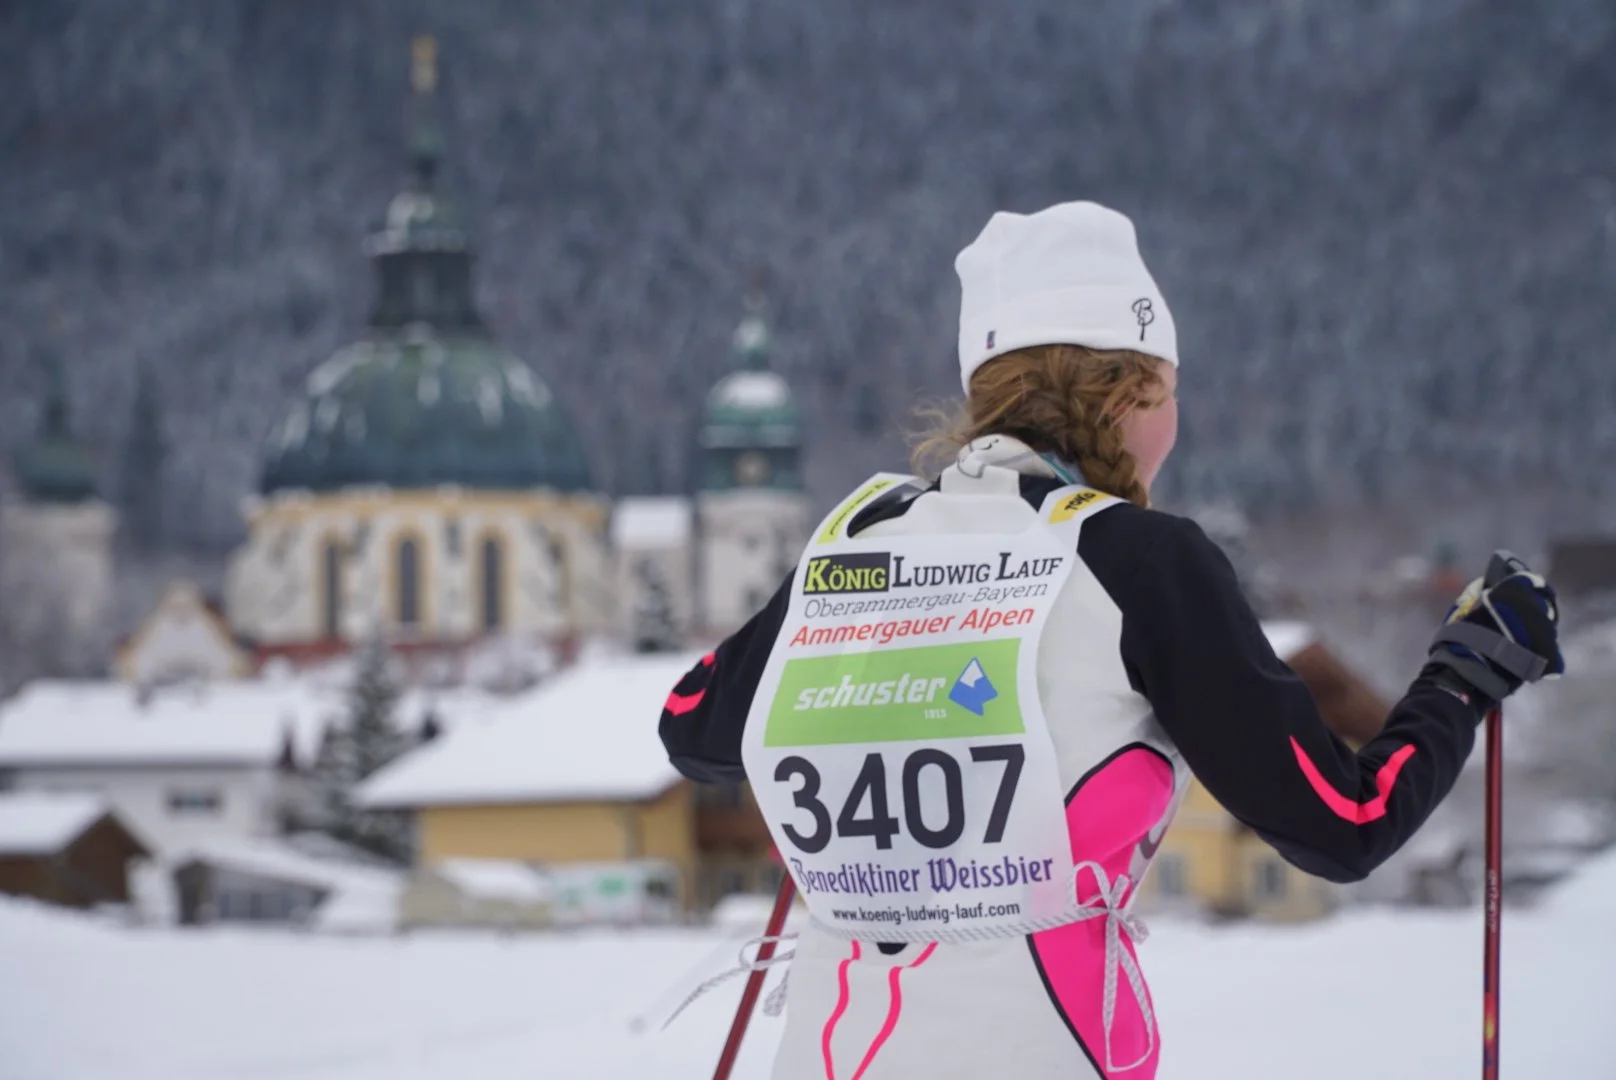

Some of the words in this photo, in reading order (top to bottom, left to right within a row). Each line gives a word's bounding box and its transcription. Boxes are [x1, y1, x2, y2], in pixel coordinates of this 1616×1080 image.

[891, 555, 991, 588] LUDWIG
[995, 551, 1064, 582] LAUF
[804, 581, 1047, 619] Oberammergau-Bayern
[789, 613, 955, 645] Ammergauer
[958, 606, 1036, 634] Alpen
[793, 673, 946, 711] schuster
[773, 743, 1025, 853] 3407
[790, 857, 920, 898] Benediktiner
[926, 854, 1053, 893] Weissbier
[832, 902, 1021, 925] www.koenig-ludwig-lauf.com
